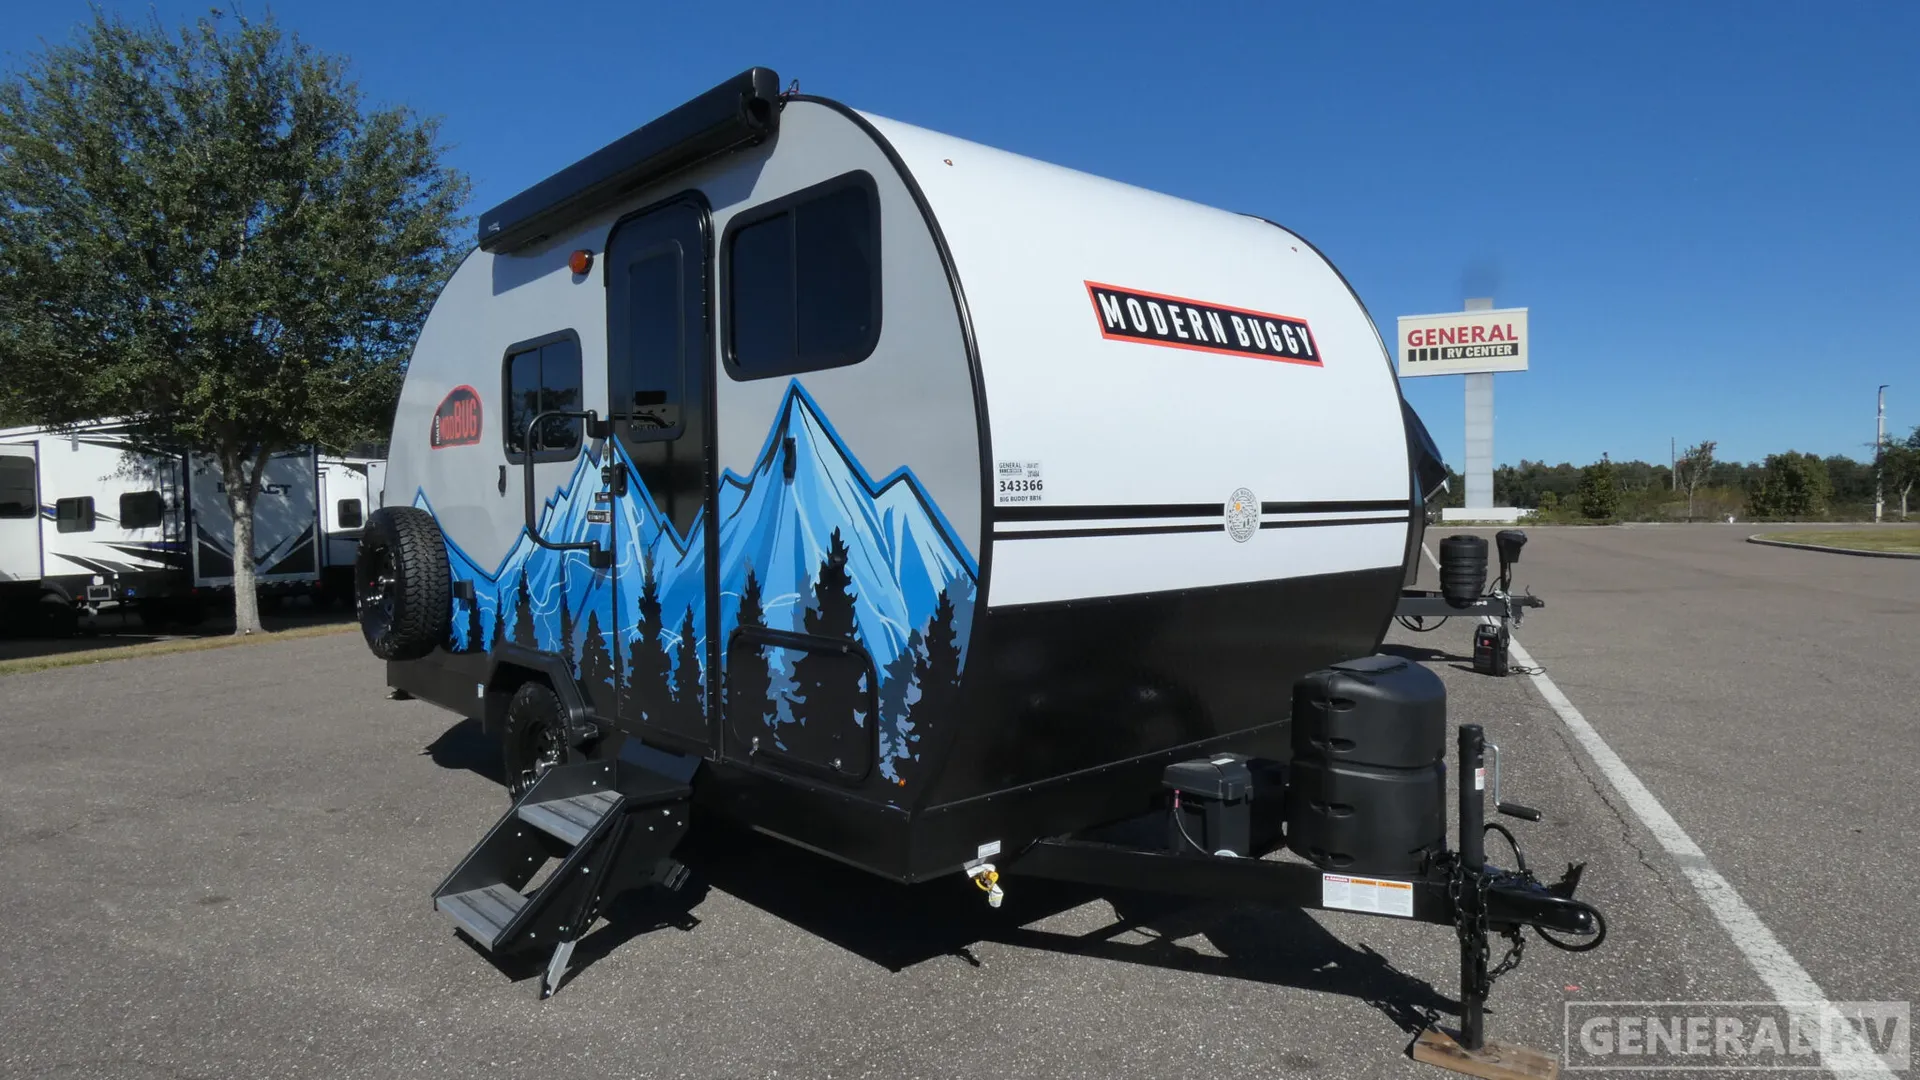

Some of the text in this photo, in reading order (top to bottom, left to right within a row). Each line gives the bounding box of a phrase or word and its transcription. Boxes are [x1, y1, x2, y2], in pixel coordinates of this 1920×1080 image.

[1098, 292, 1314, 356] MODERN BUGGY
[1407, 323, 1519, 347] GENERAL
[1446, 345, 1513, 359] RV CENTER
[999, 480, 1043, 492] 343366
